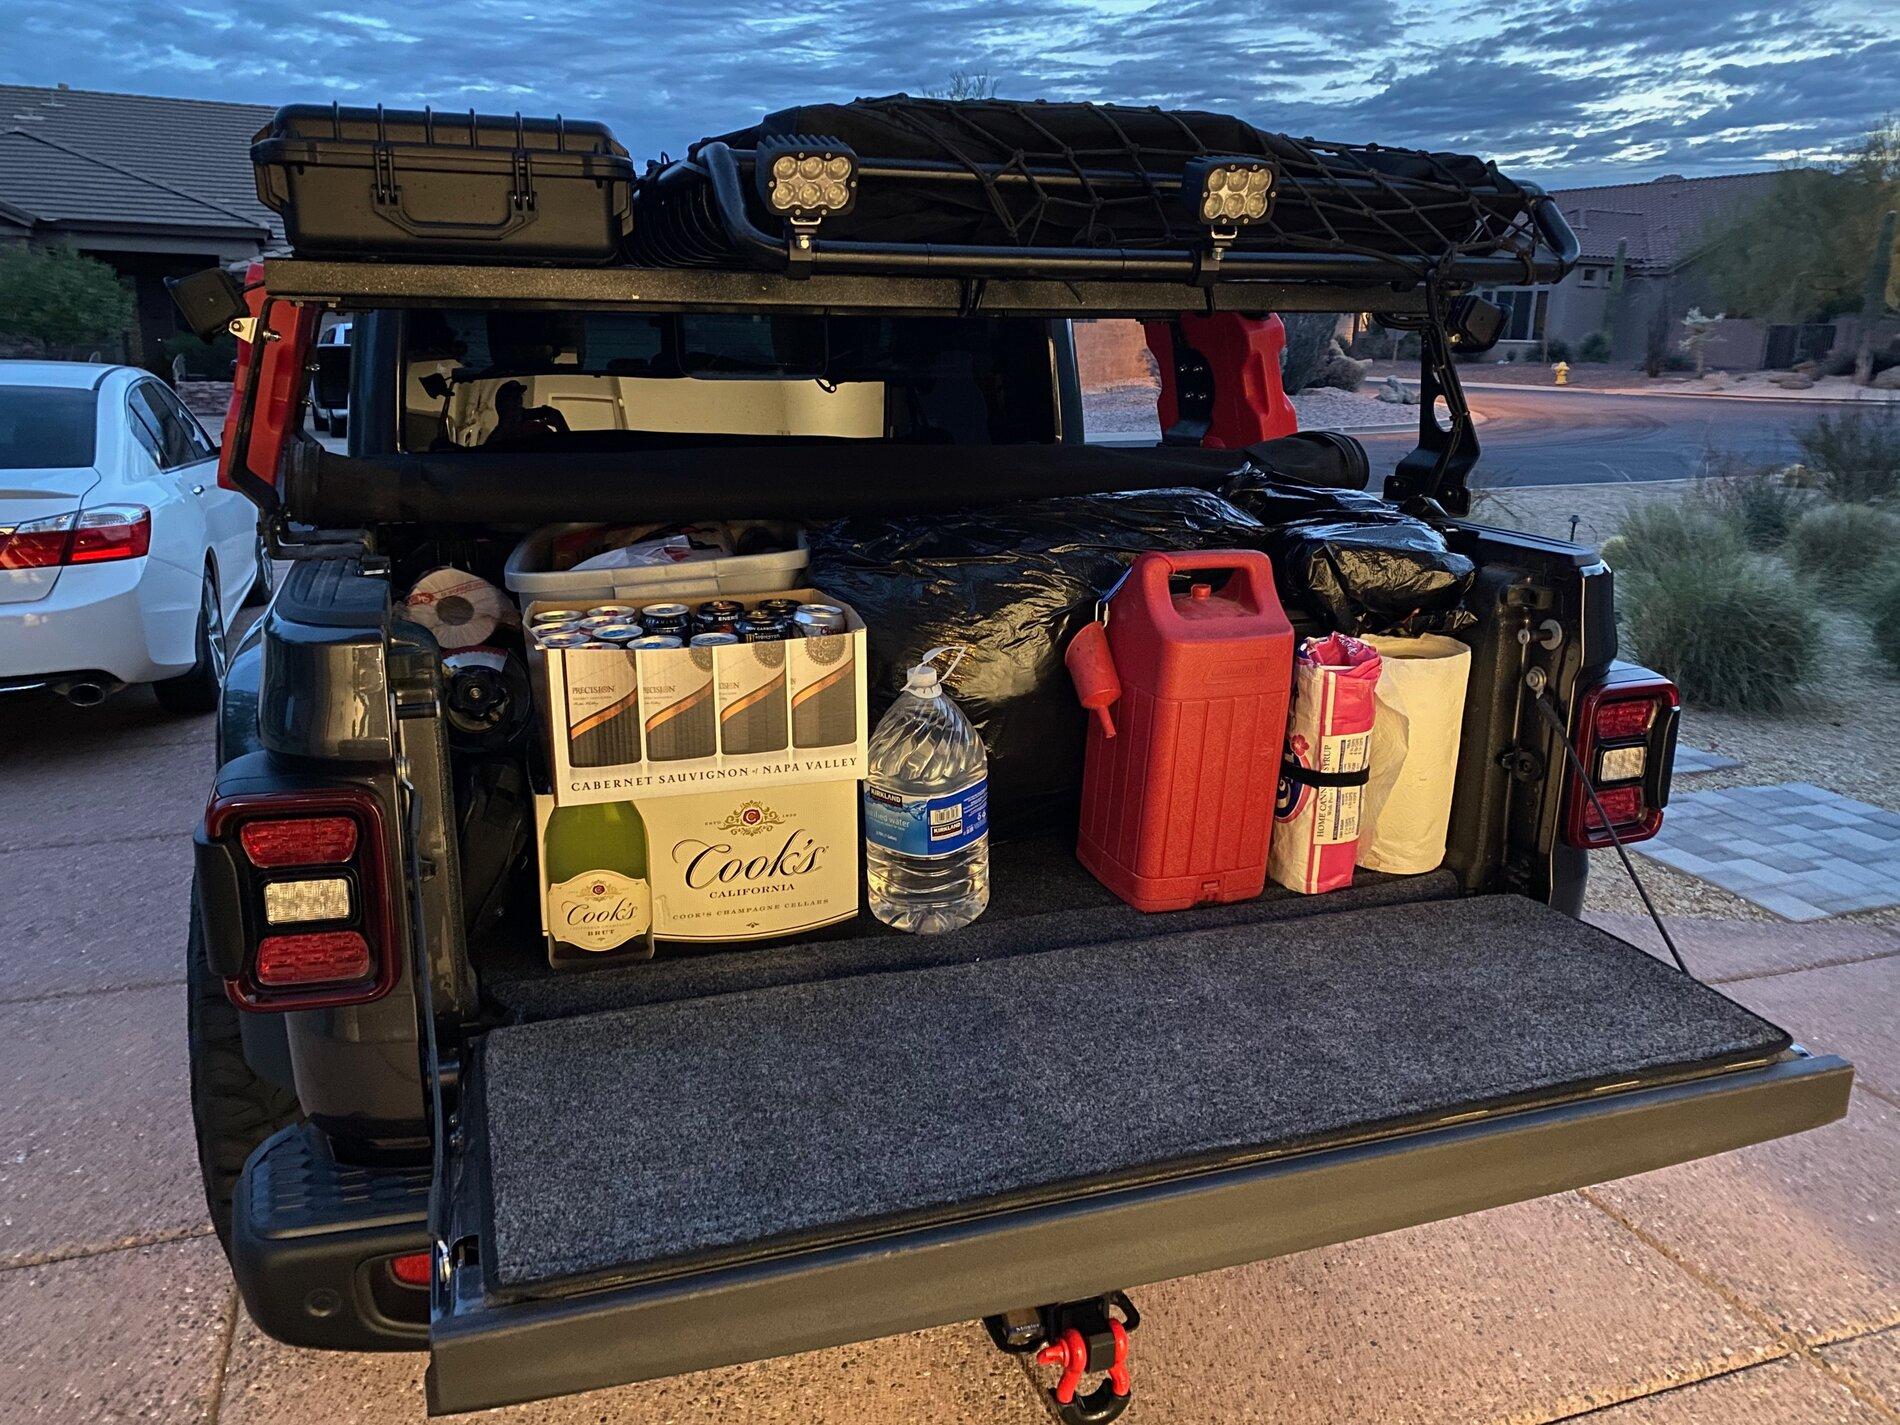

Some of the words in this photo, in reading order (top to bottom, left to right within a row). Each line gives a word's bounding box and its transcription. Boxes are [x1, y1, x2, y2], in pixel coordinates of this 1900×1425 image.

[572, 685, 615, 694] PRECISION
[1322, 744, 1332, 771] SYRUP
[571, 776, 653, 792] CABERNET
[658, 767, 748, 784] SAUVIGNON
[763, 763, 800, 775] NAPA
[805, 757, 857, 771] VALLEY
[870, 788, 901, 803] KIRKLAND
[1319, 787, 1327, 812] CANN
[1317, 813, 1326, 837] HOME
[671, 828, 827, 890] Cook's
[709, 883, 795, 899] CALIFORNIA
[561, 897, 638, 926] Cook's
[672, 911, 712, 920] COOK'S
[716, 904, 780, 916] CHAMPAGNE
[784, 898, 829, 909] CELLARS
[587, 929, 615, 937] BRUT
